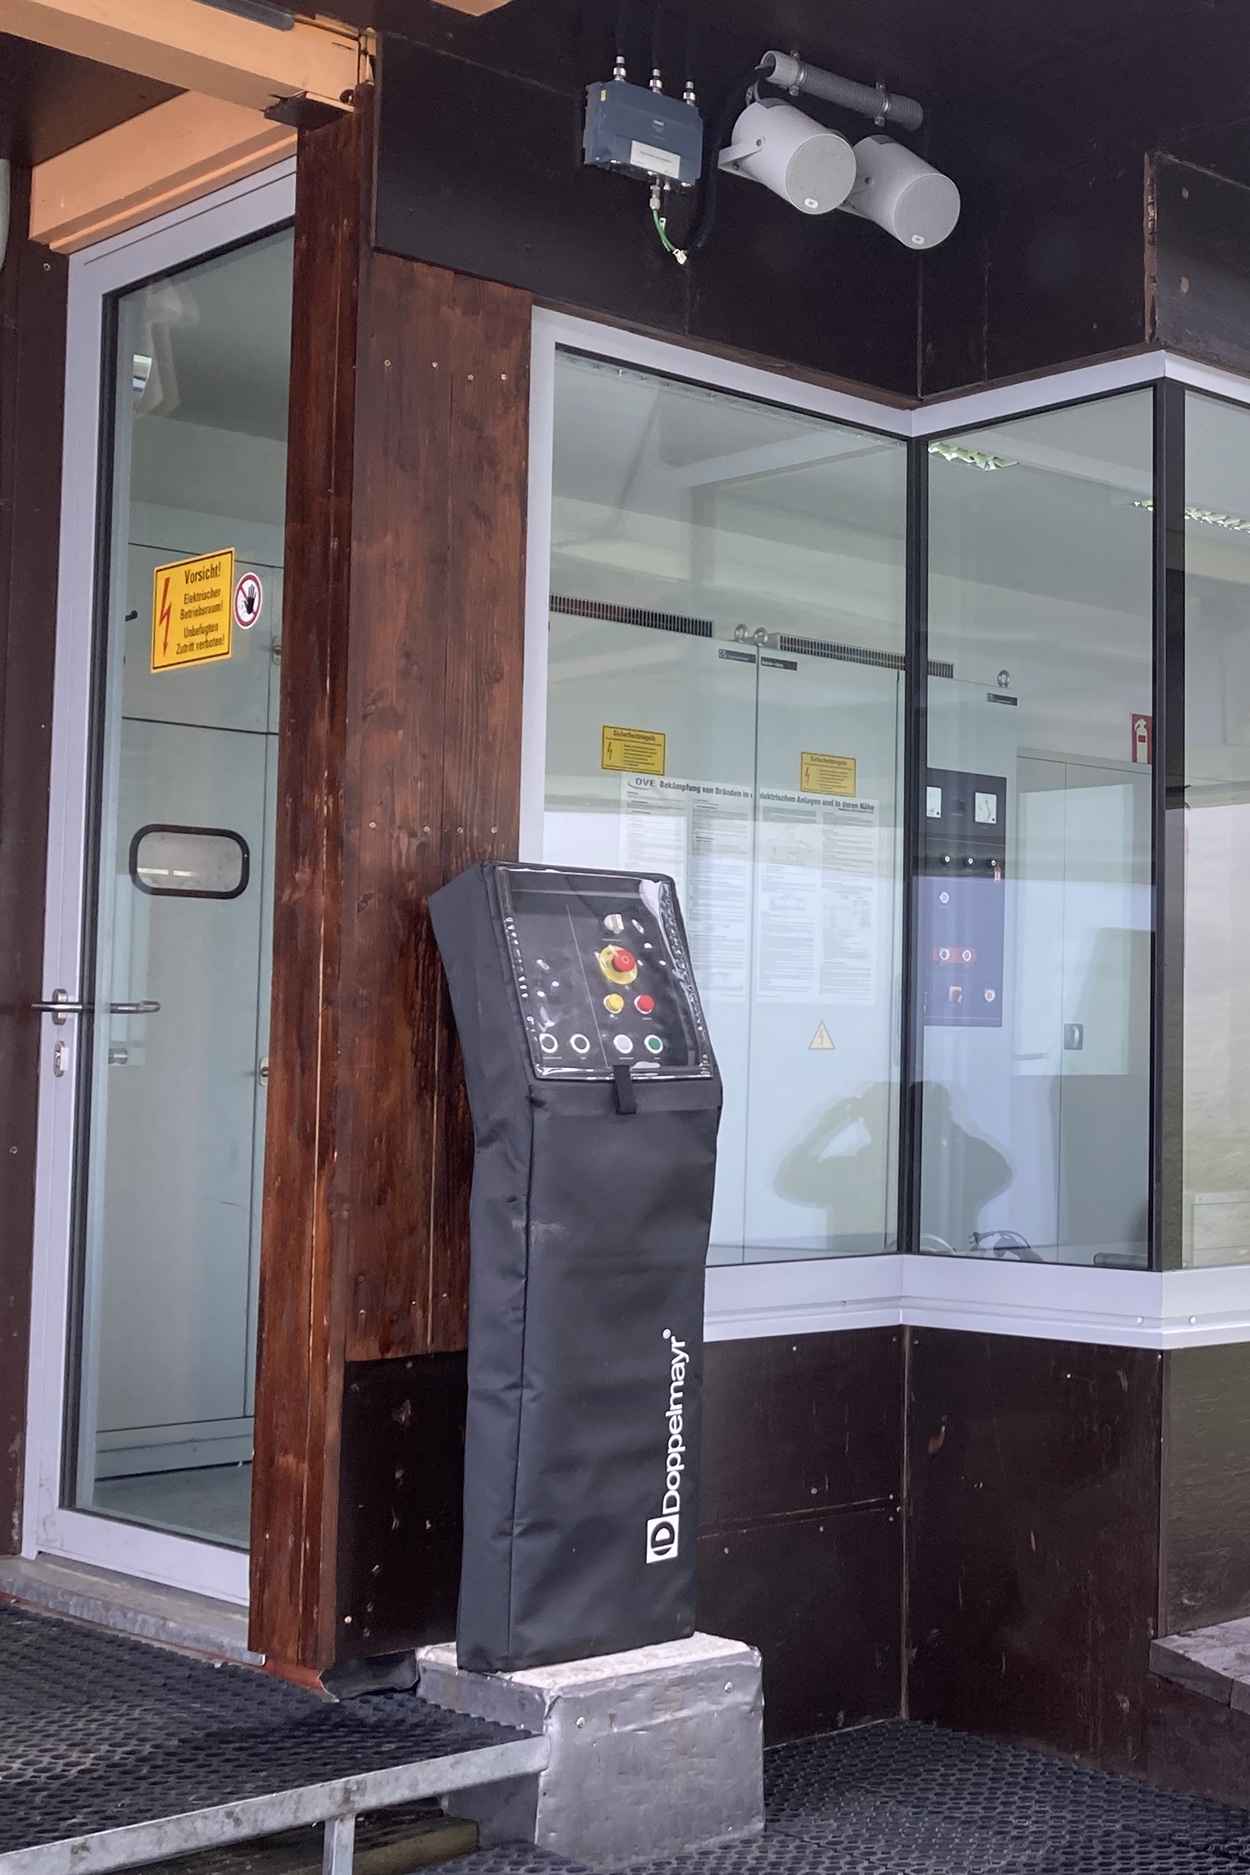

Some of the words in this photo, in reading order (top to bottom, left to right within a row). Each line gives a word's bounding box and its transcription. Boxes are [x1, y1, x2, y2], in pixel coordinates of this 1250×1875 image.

[184, 561, 222, 585] Vorsicht!
[183, 587, 222, 605] Elektrischer
[180, 600, 224, 621] Betriebsraum!
[183, 623, 219, 639] Unbefugten
[176, 641, 195, 655] Zutritt
[195, 633, 225, 651] verboten!
[660, 780, 701, 794] Bekämpfung
[702, 786, 714, 794] von
[715, 787, 742, 798] Bränden
[797, 796, 821, 806] Anlagen
[822, 799, 834, 807] und
[842, 801, 859, 809] deren
[662, 1335, 690, 1515] Doppelmayr
